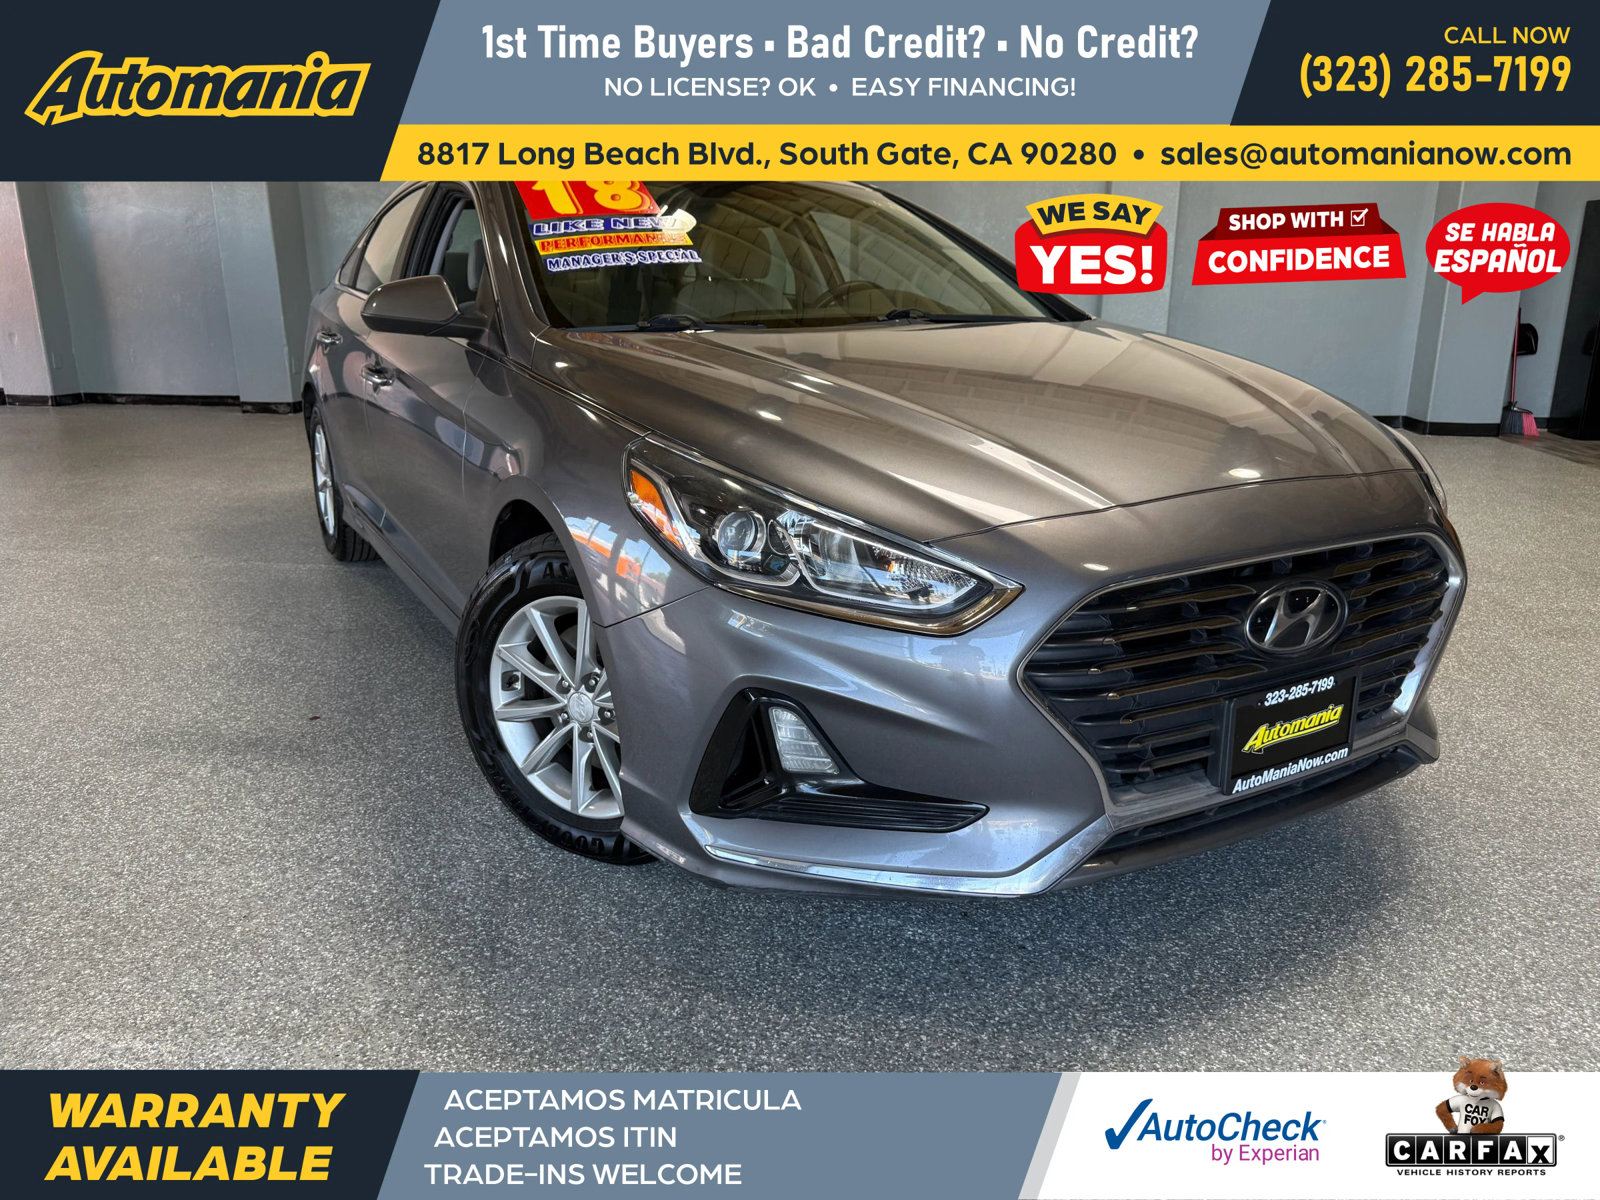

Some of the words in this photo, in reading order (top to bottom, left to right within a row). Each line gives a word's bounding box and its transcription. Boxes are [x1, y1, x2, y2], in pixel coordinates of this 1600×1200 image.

[533, 217, 605, 236] LIKE
[540, 231, 687, 252] PERFORMANE
[547, 252, 636, 272] MANAGER'S
[1264, 676, 1335, 706] 323-285-7199
[1241, 704, 1344, 755] Automania
[1232, 747, 1349, 794] AutoManiaNow.com
